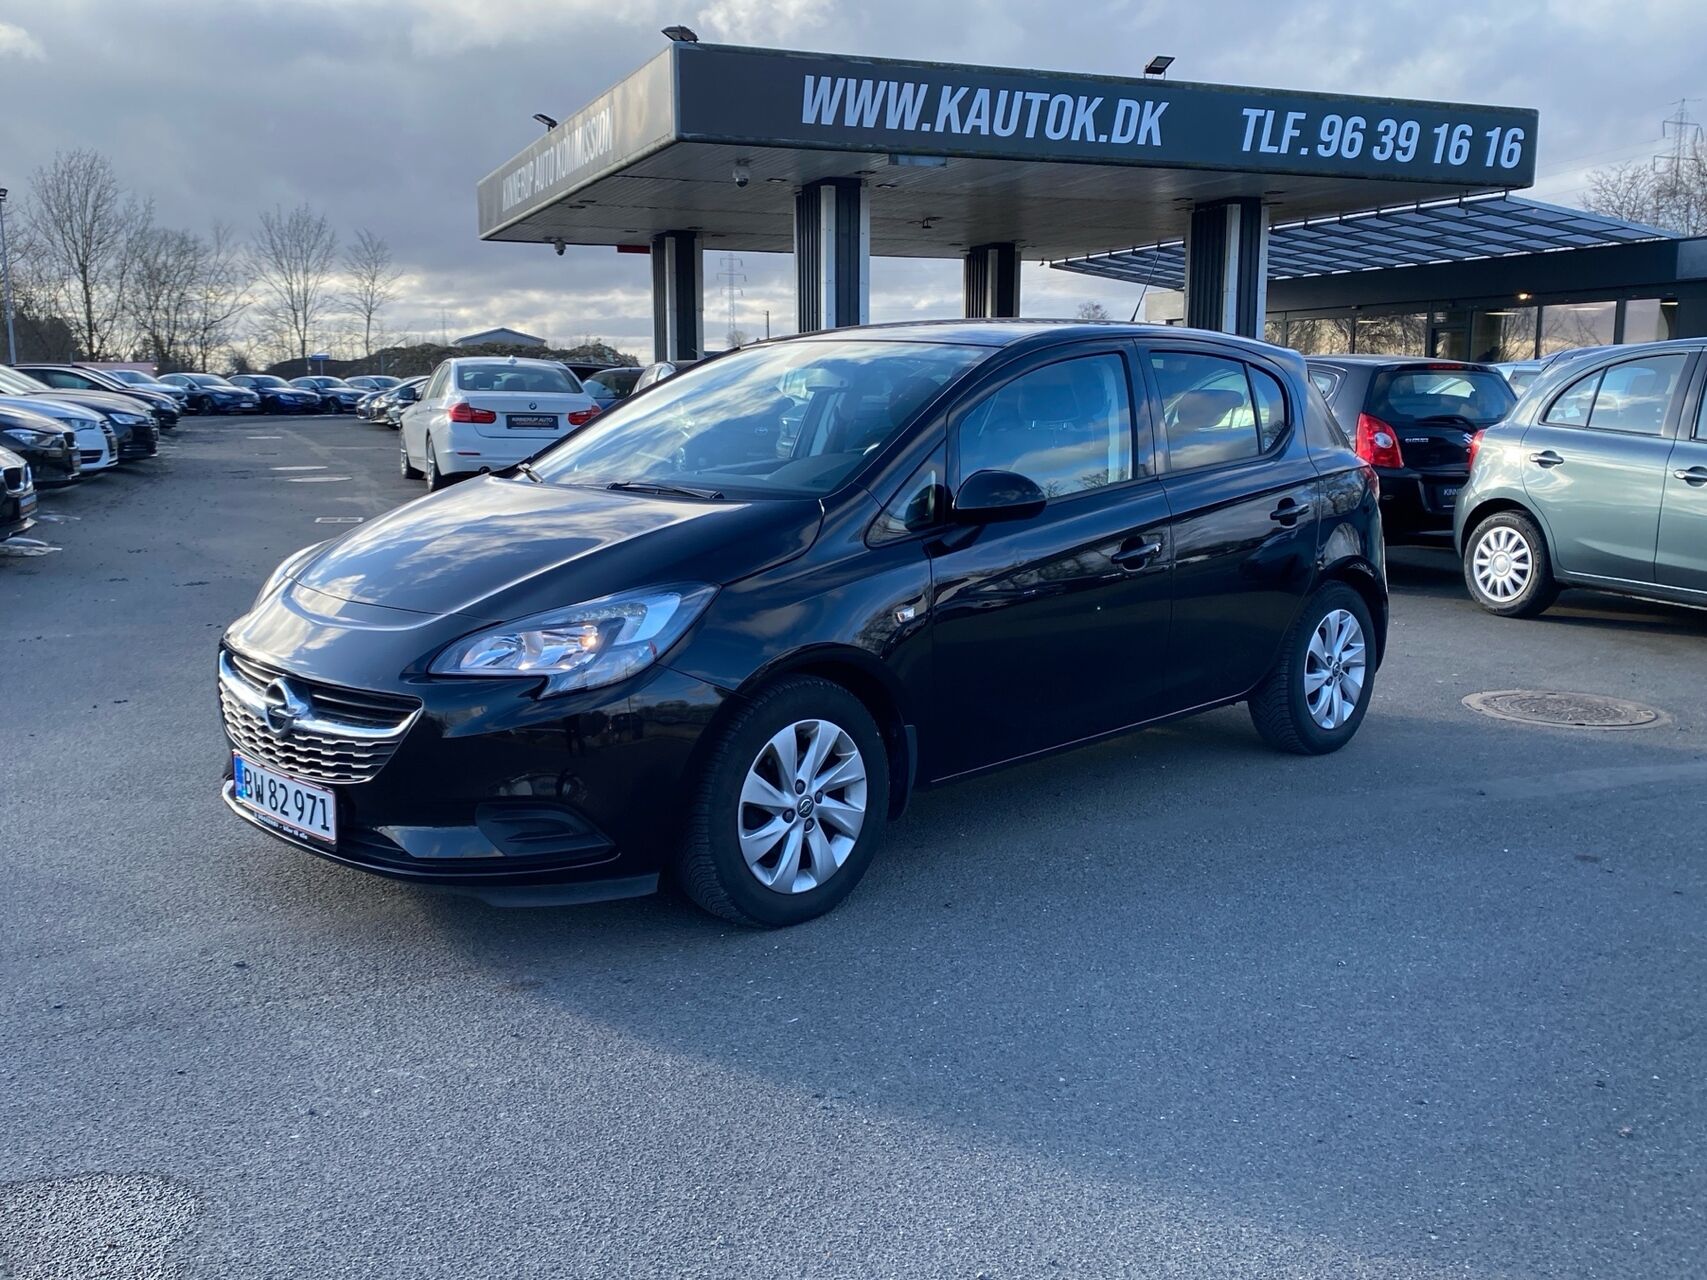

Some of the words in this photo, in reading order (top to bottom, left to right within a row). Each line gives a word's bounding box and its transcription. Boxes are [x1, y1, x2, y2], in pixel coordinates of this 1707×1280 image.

[802, 75, 1169, 146] WWW.KAUTOK.DK
[1241, 108, 1308, 155] TLF.
[1317, 114, 1366, 158] 96
[1373, 118, 1421, 162] 39
[1432, 123, 1473, 165] 16
[1485, 127, 1525, 169] 16
[244, 767, 264, 805] BW
[268, 778, 289, 817] 82
[294, 789, 330, 832] 971
